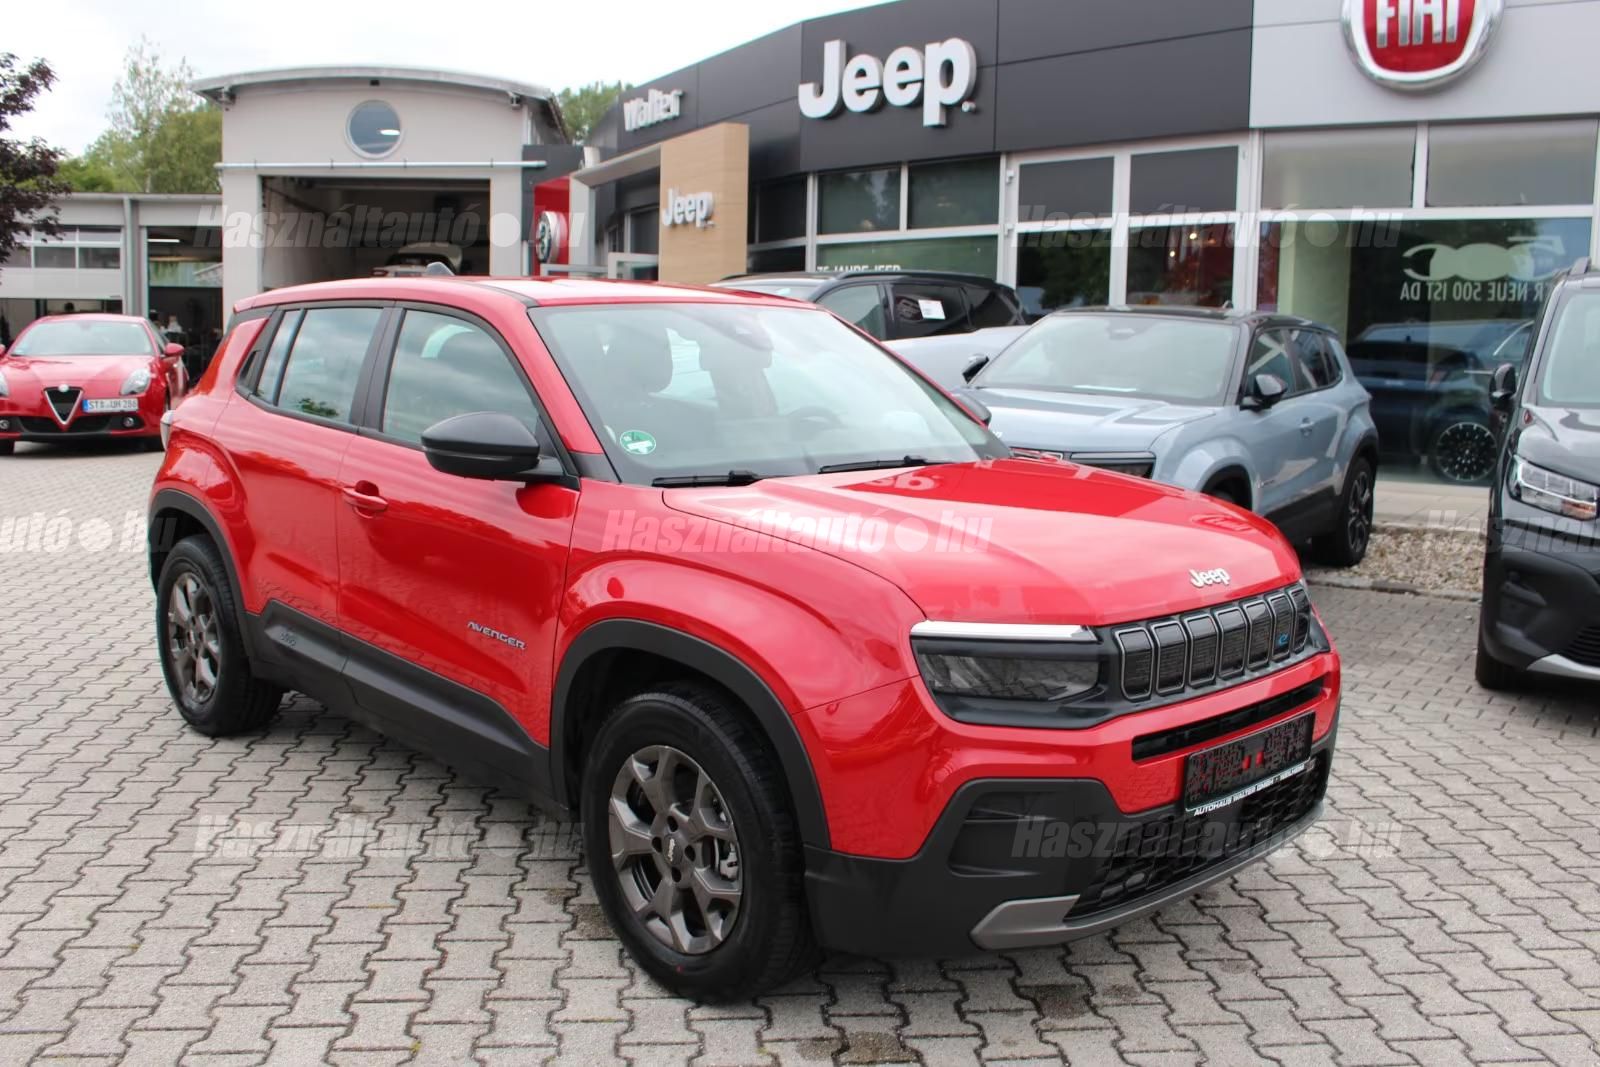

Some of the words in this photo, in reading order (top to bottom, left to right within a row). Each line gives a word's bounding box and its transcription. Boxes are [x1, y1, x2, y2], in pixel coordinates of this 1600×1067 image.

[798, 37, 977, 127] Jeep
[623, 88, 683, 132] Walter
[661, 187, 714, 228] Jeep
[1189, 567, 1231, 588] Jeep
[467, 621, 526, 650] AVENGER
[1194, 797, 1232, 816] AUTOHAUS
